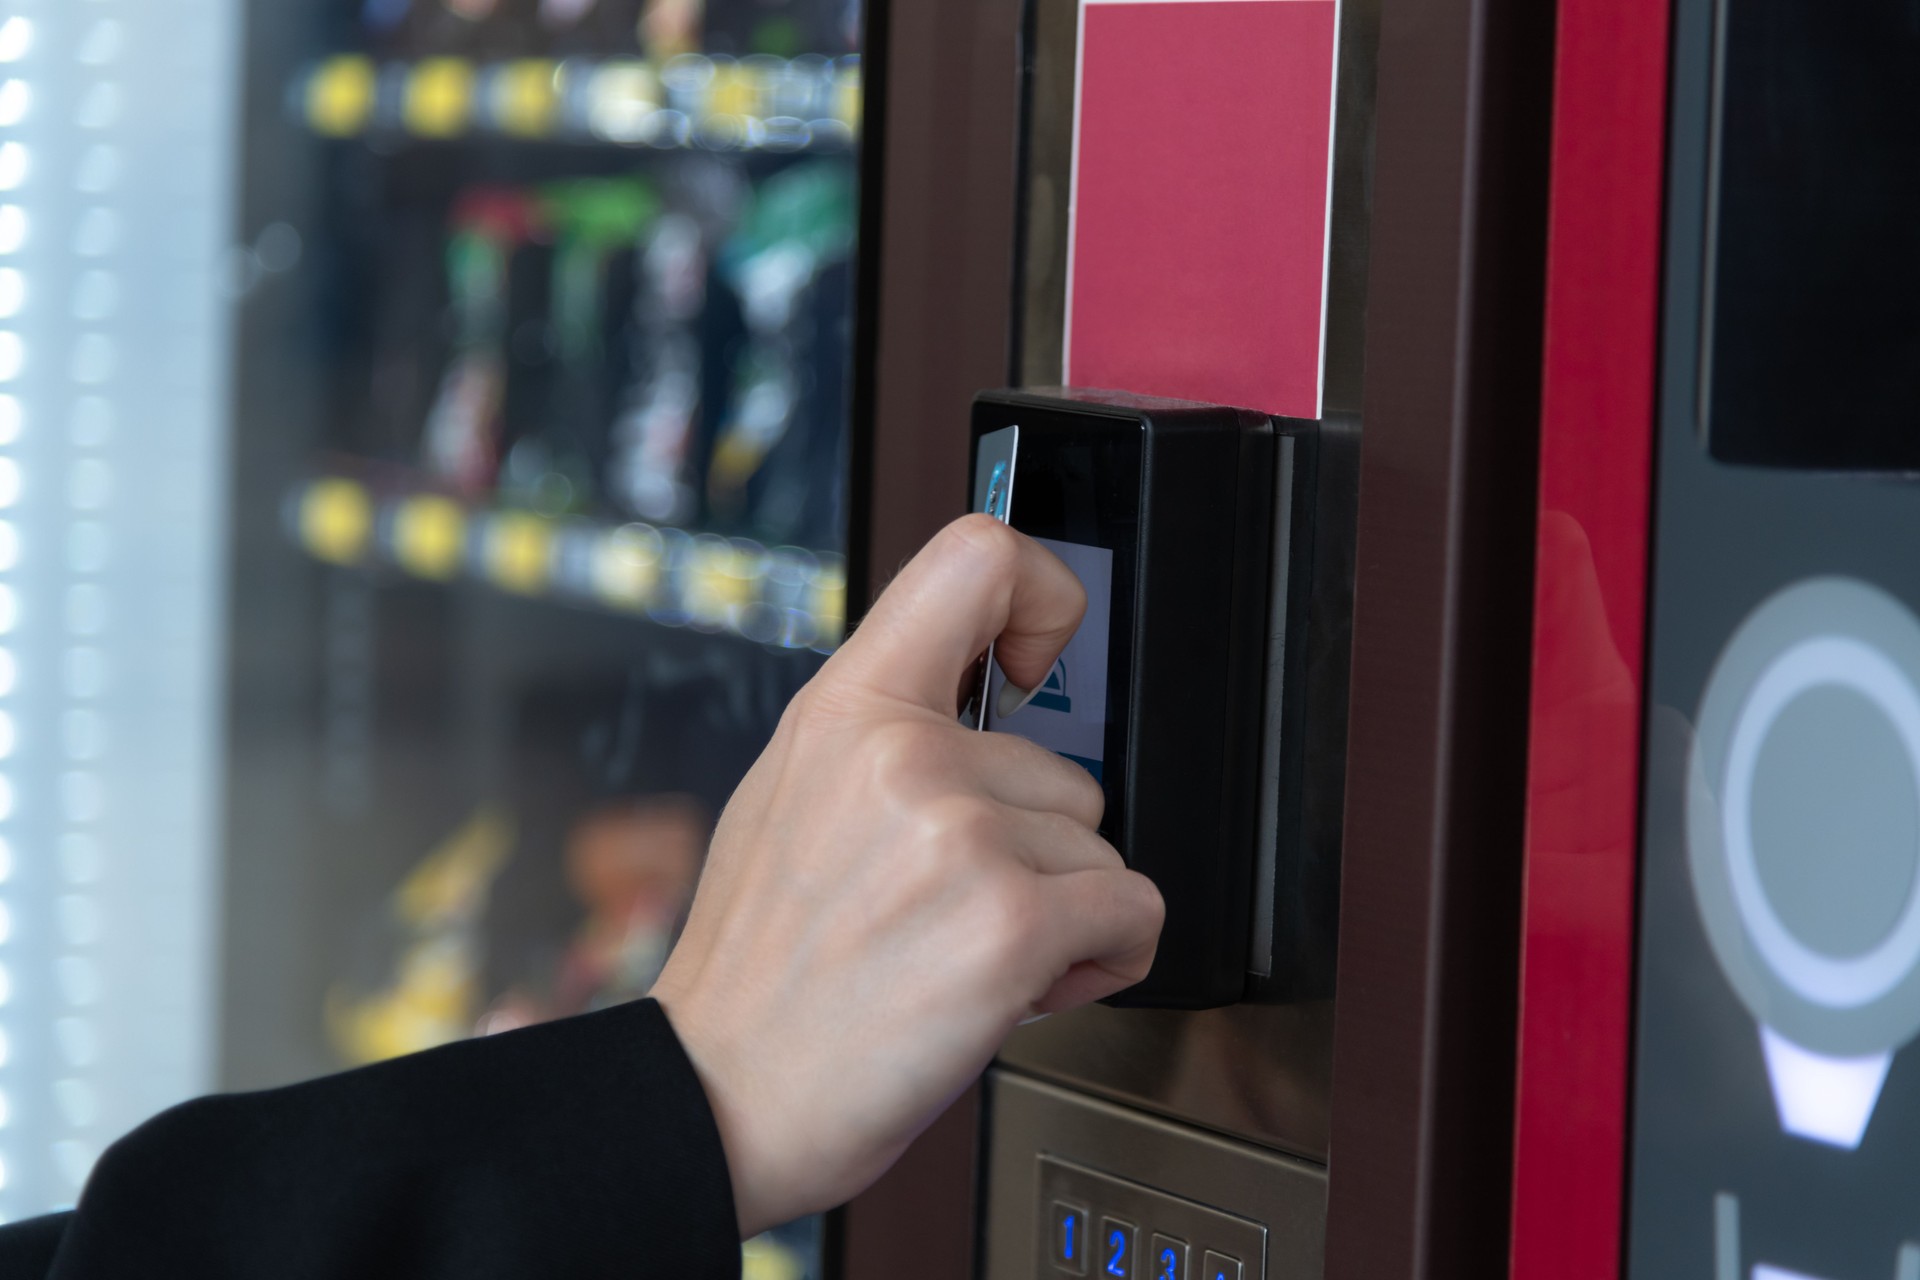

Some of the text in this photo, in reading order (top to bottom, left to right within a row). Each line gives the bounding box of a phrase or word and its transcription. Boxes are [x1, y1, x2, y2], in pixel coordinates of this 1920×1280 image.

[1063, 1215, 1177, 1280] 1 2 3
